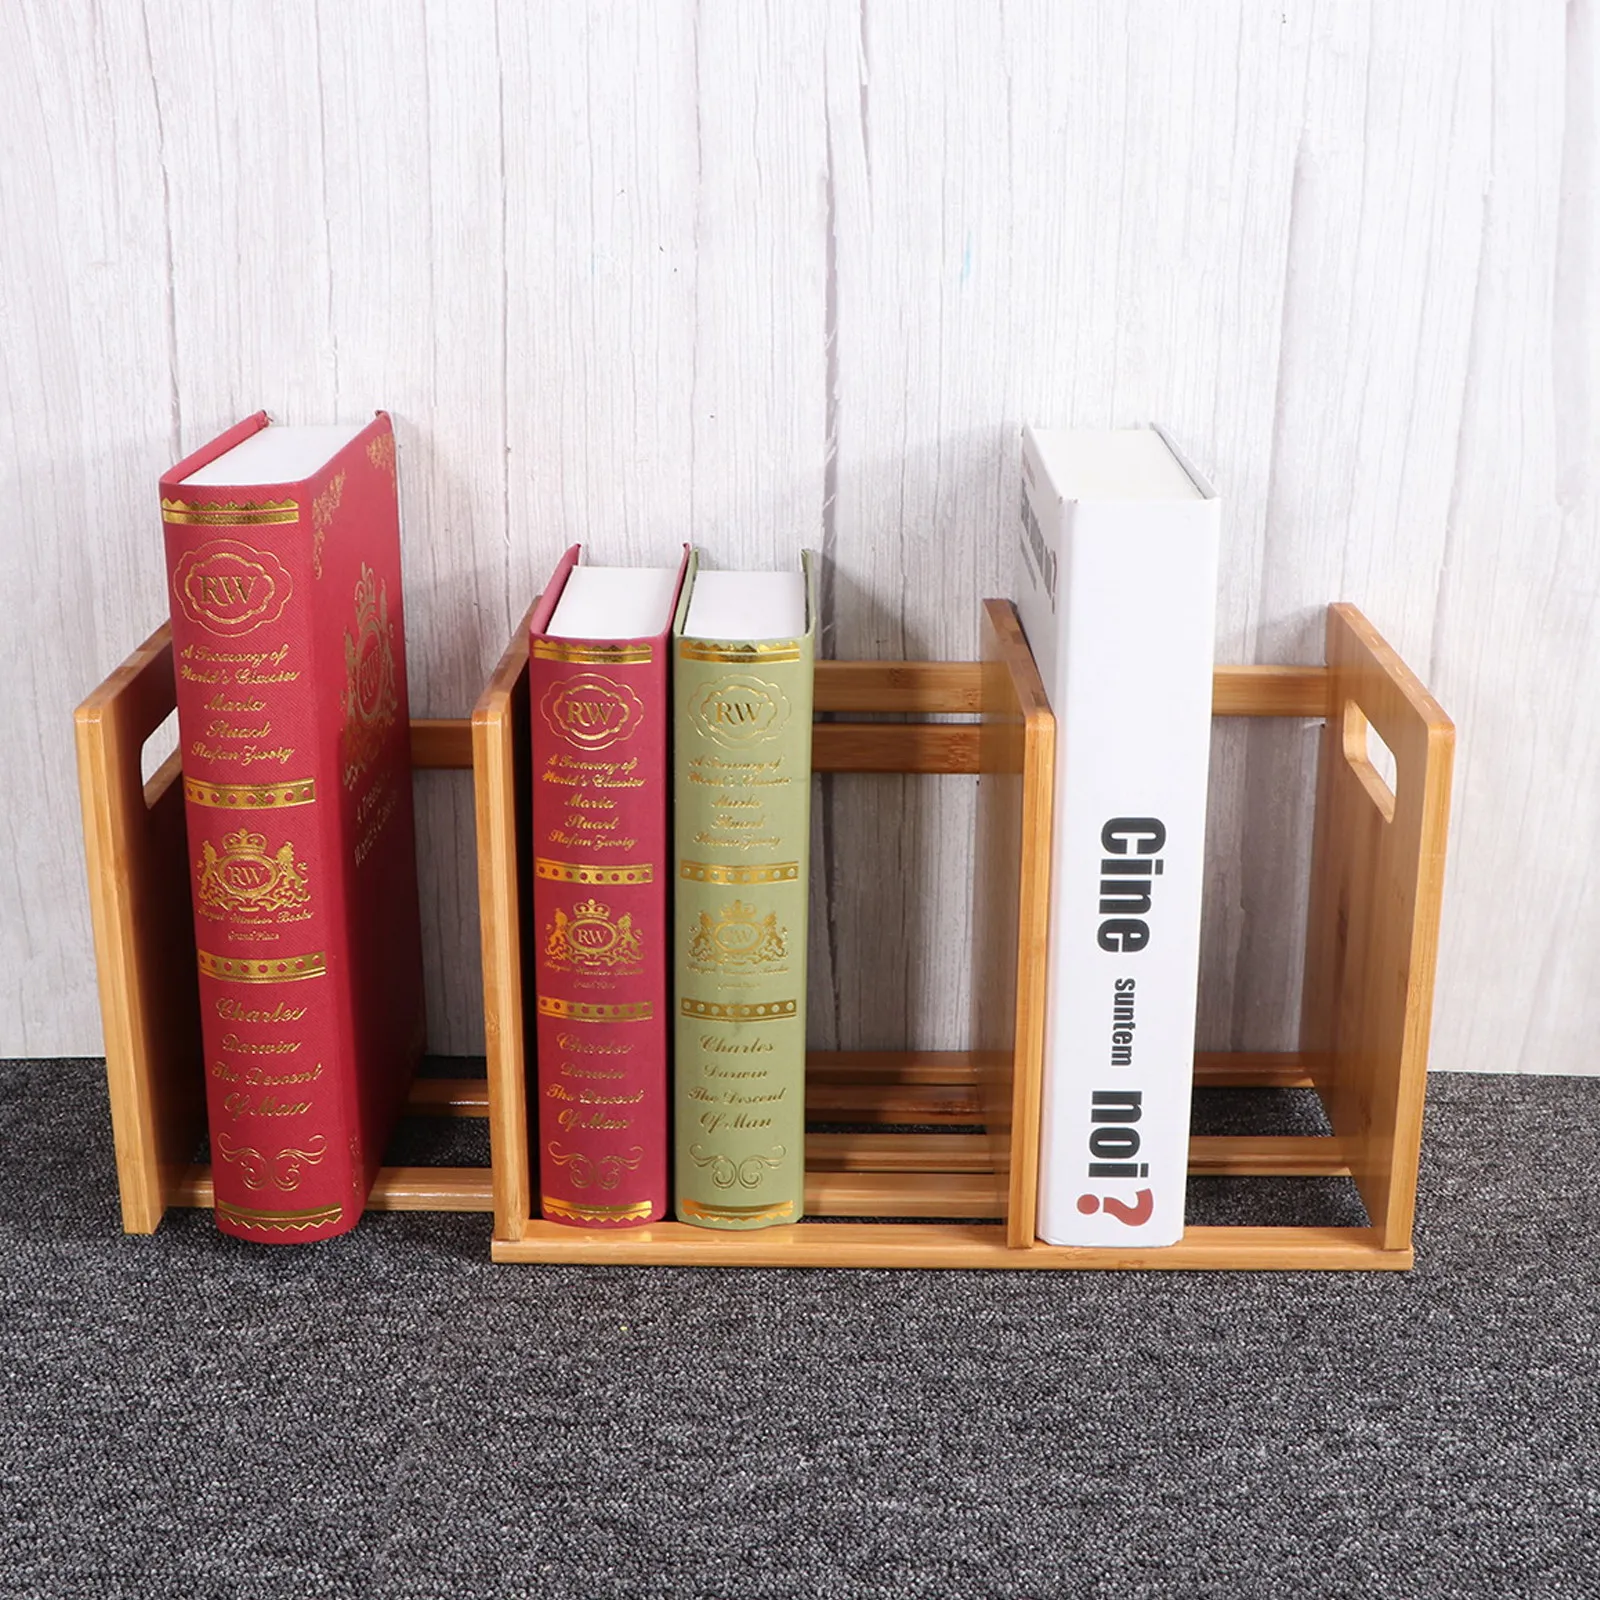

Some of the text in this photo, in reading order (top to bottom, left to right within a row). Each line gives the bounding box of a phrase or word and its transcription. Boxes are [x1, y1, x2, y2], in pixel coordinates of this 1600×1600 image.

[198, 576, 256, 606] RW
[269, 643, 289, 667] of
[565, 701, 615, 727] RW
[714, 702, 763, 725] RW
[621, 757, 639, 775] of
[564, 793, 617, 809] Maria
[564, 815, 620, 830] Stuart
[228, 866, 265, 886] RW
[577, 929, 608, 945] RW
[216, 998, 308, 1022] Charles
[1076, 817, 1167, 1227] Cine suntem noi?
[222, 1033, 301, 1054] Darwin
[700, 1035, 774, 1055] Charles
[212, 1061, 240, 1082] The
[704, 1064, 768, 1080] Darwin
[545, 1083, 574, 1101] The
[688, 1086, 787, 1105] The Descent
[224, 1092, 313, 1122] Of Man
[558, 1108, 581, 1132] Of
[700, 1111, 772, 1135] Of Man
